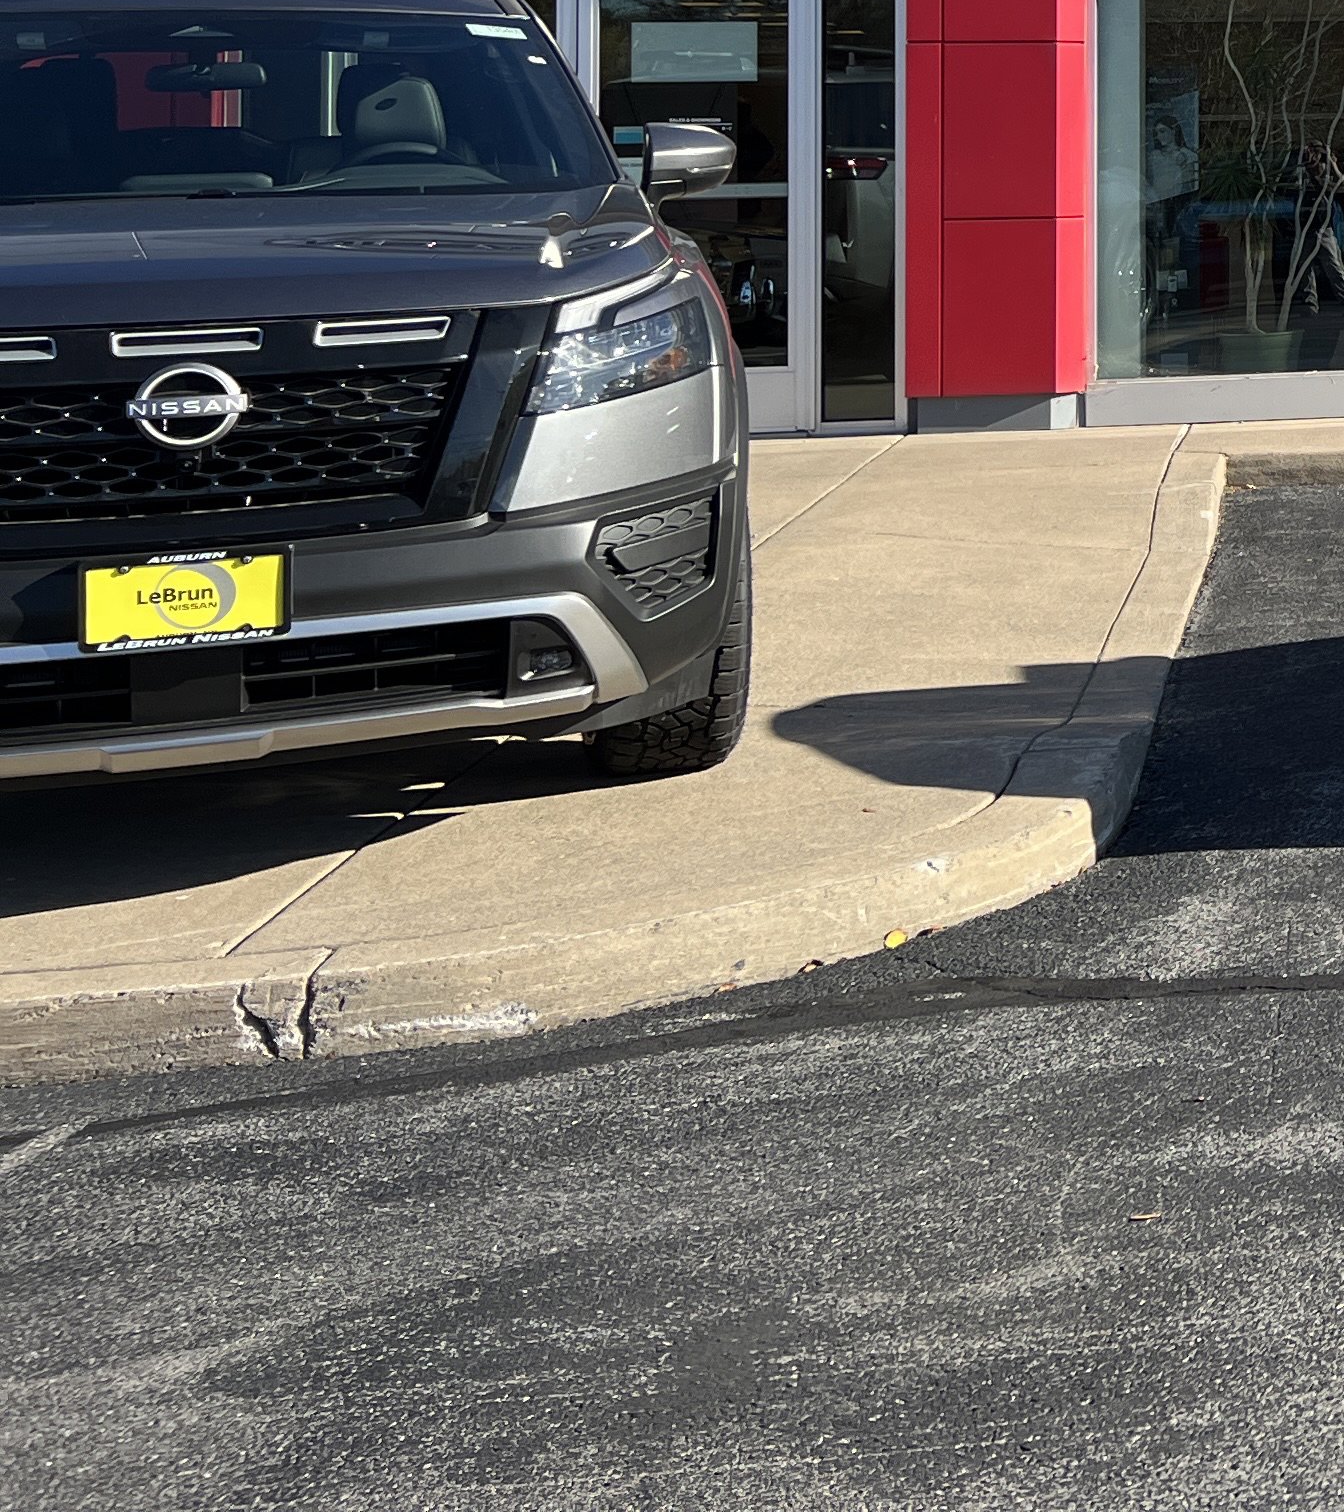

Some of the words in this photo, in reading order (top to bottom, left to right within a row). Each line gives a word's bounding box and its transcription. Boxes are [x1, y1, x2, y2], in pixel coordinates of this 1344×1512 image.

[128, 398, 244, 416] NISSAN
[147, 551, 227, 565] AUBURN
[136, 587, 214, 606] LeBrun
[168, 601, 218, 612] NISSAN
